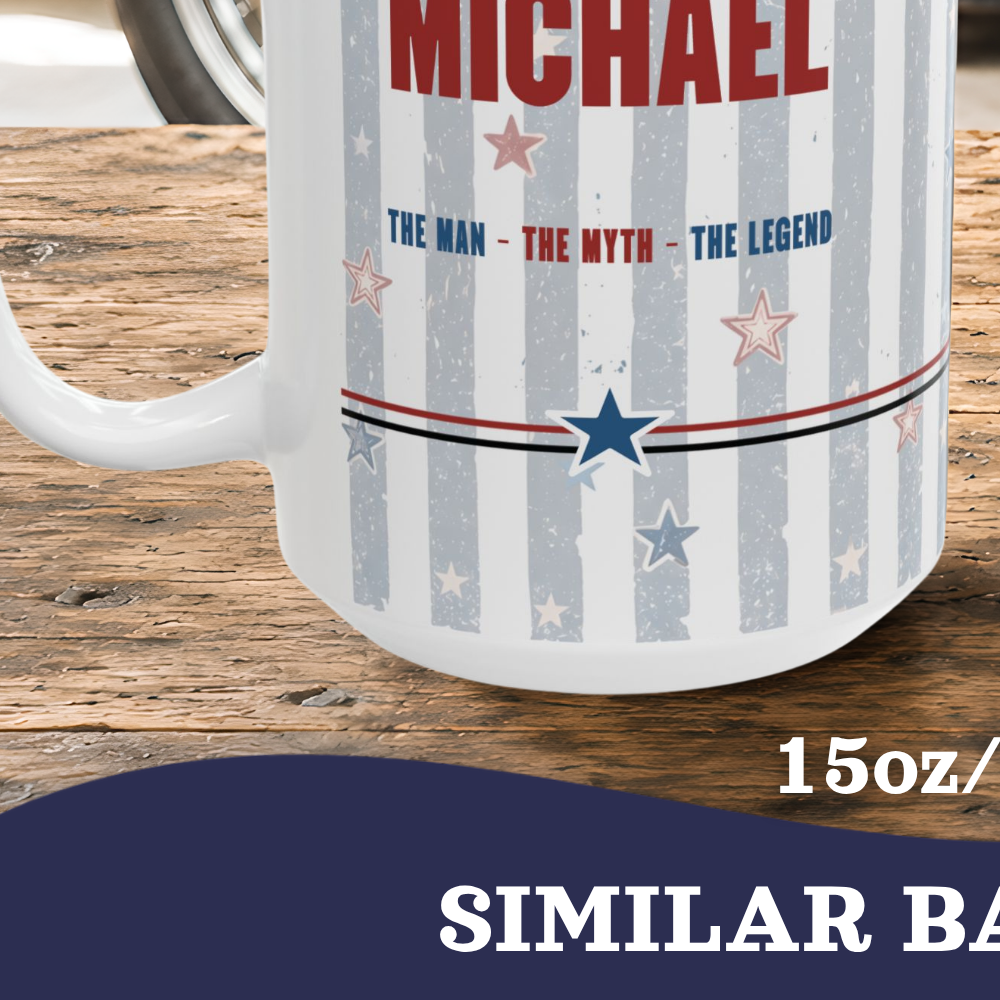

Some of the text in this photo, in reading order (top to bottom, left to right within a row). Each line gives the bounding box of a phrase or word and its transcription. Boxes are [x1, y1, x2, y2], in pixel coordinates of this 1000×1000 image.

[387, 207, 426, 249] THE
[436, 216, 486, 258] MAN
[521, 225, 570, 263] THE
[581, 227, 654, 264] MYTH
[690, 223, 738, 261] THE
[747, 209, 833, 256] LEGEND
